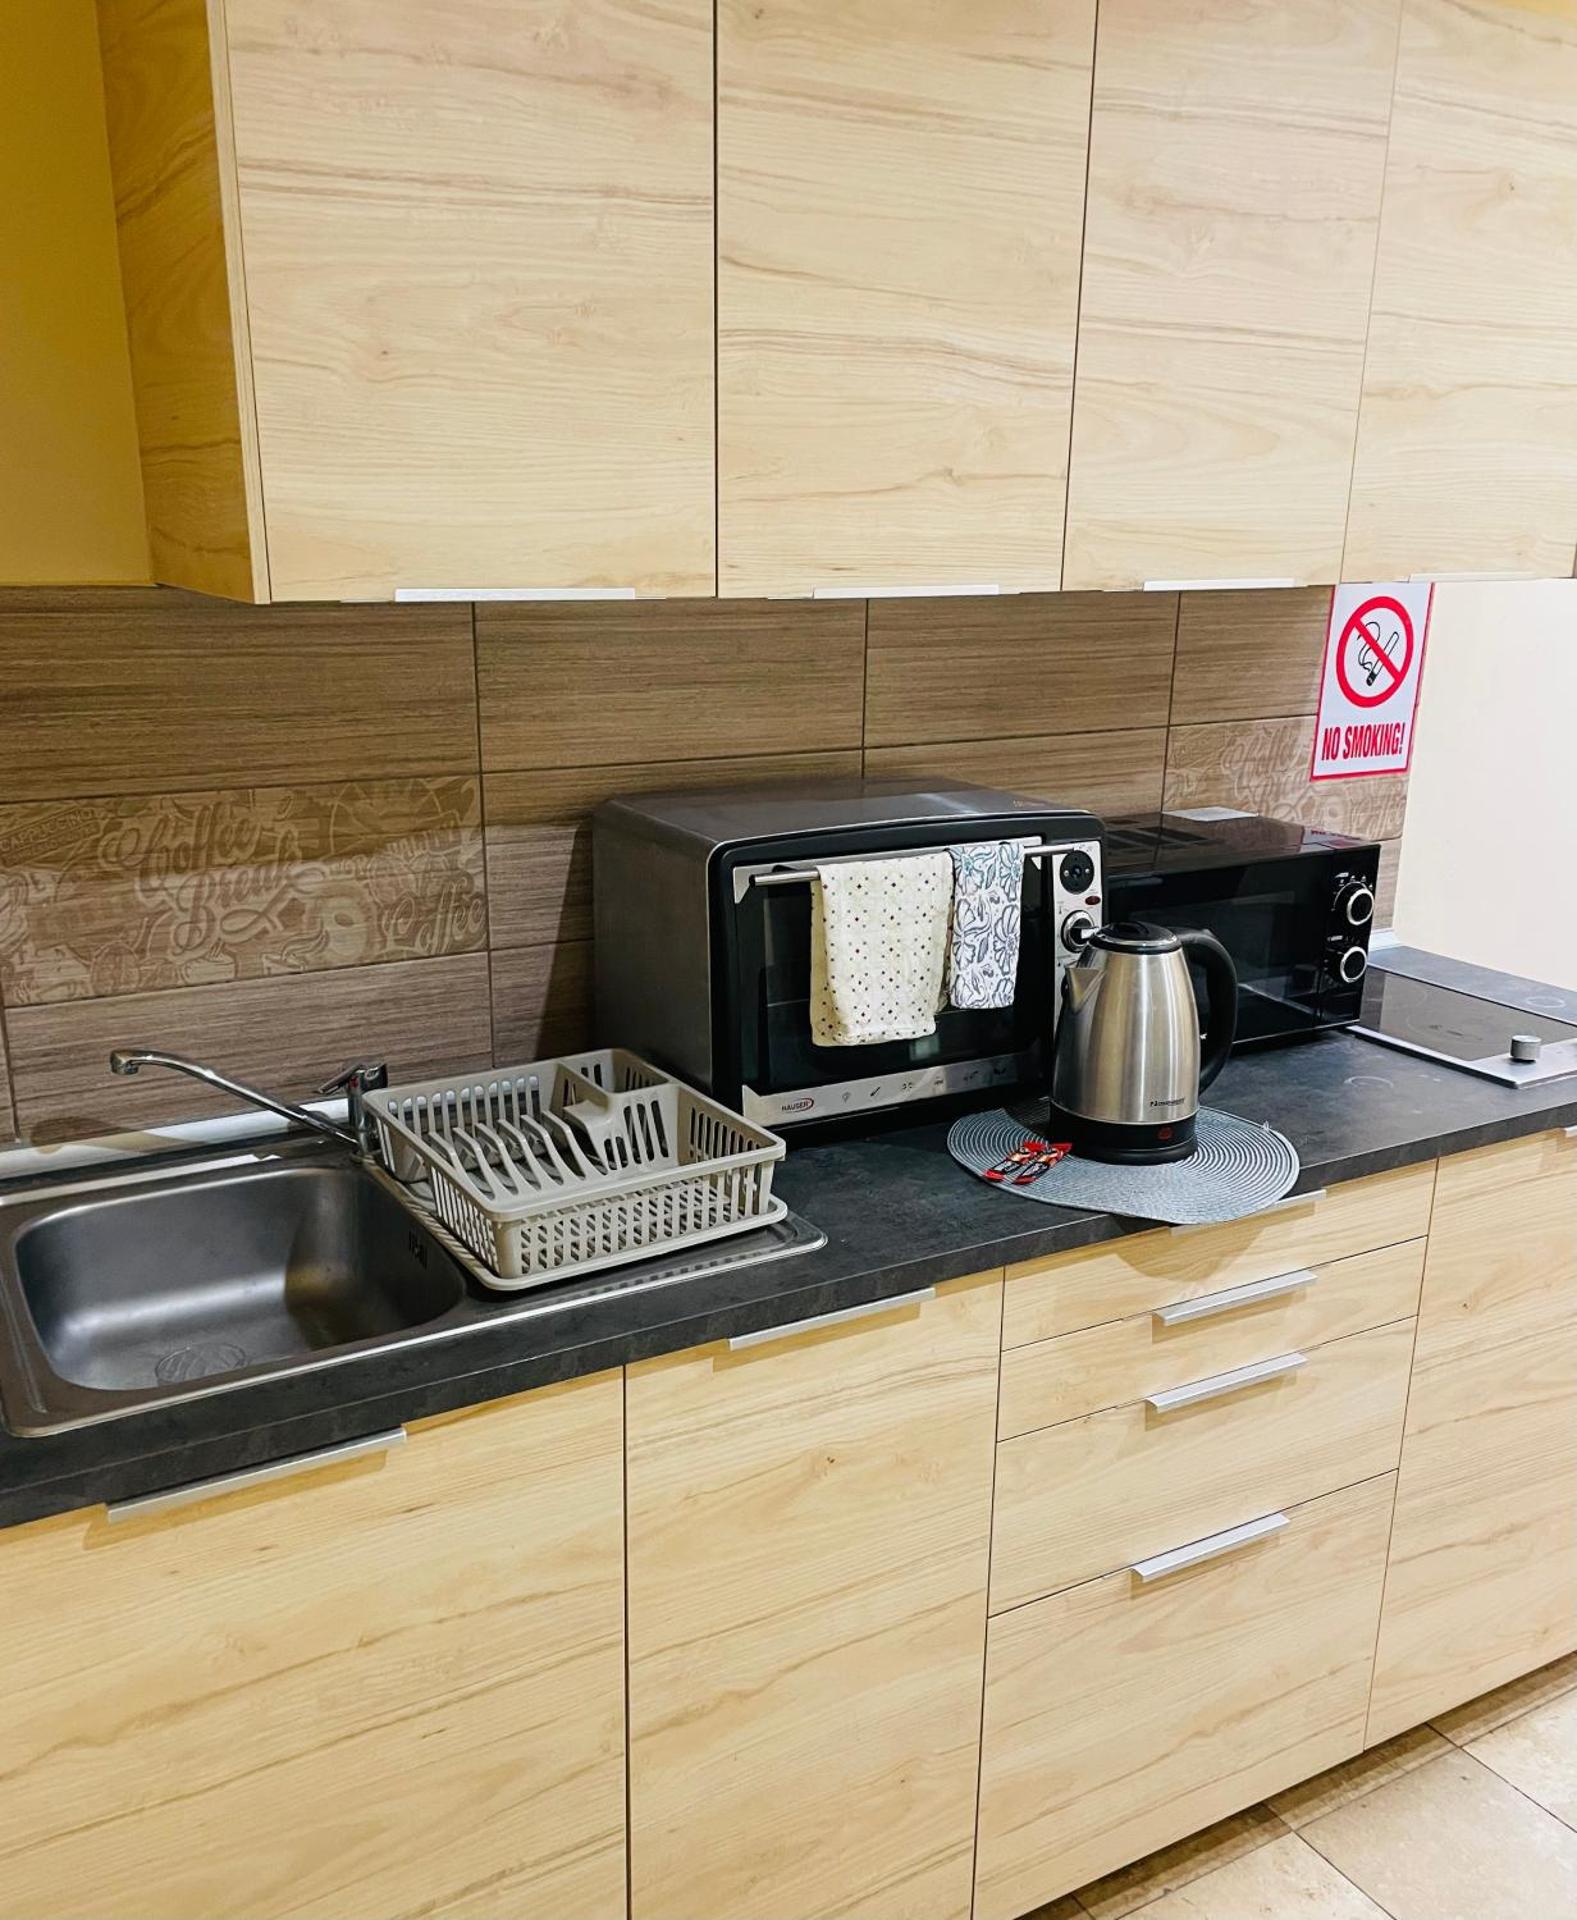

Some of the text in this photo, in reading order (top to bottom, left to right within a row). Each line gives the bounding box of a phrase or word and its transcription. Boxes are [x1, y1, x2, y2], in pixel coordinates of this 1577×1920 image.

[1321, 722, 1405, 760] NO SMOKING!
[102, 801, 260, 895] Coffee
[172, 828, 306, 956] Break
[380, 868, 487, 953] Coffee
